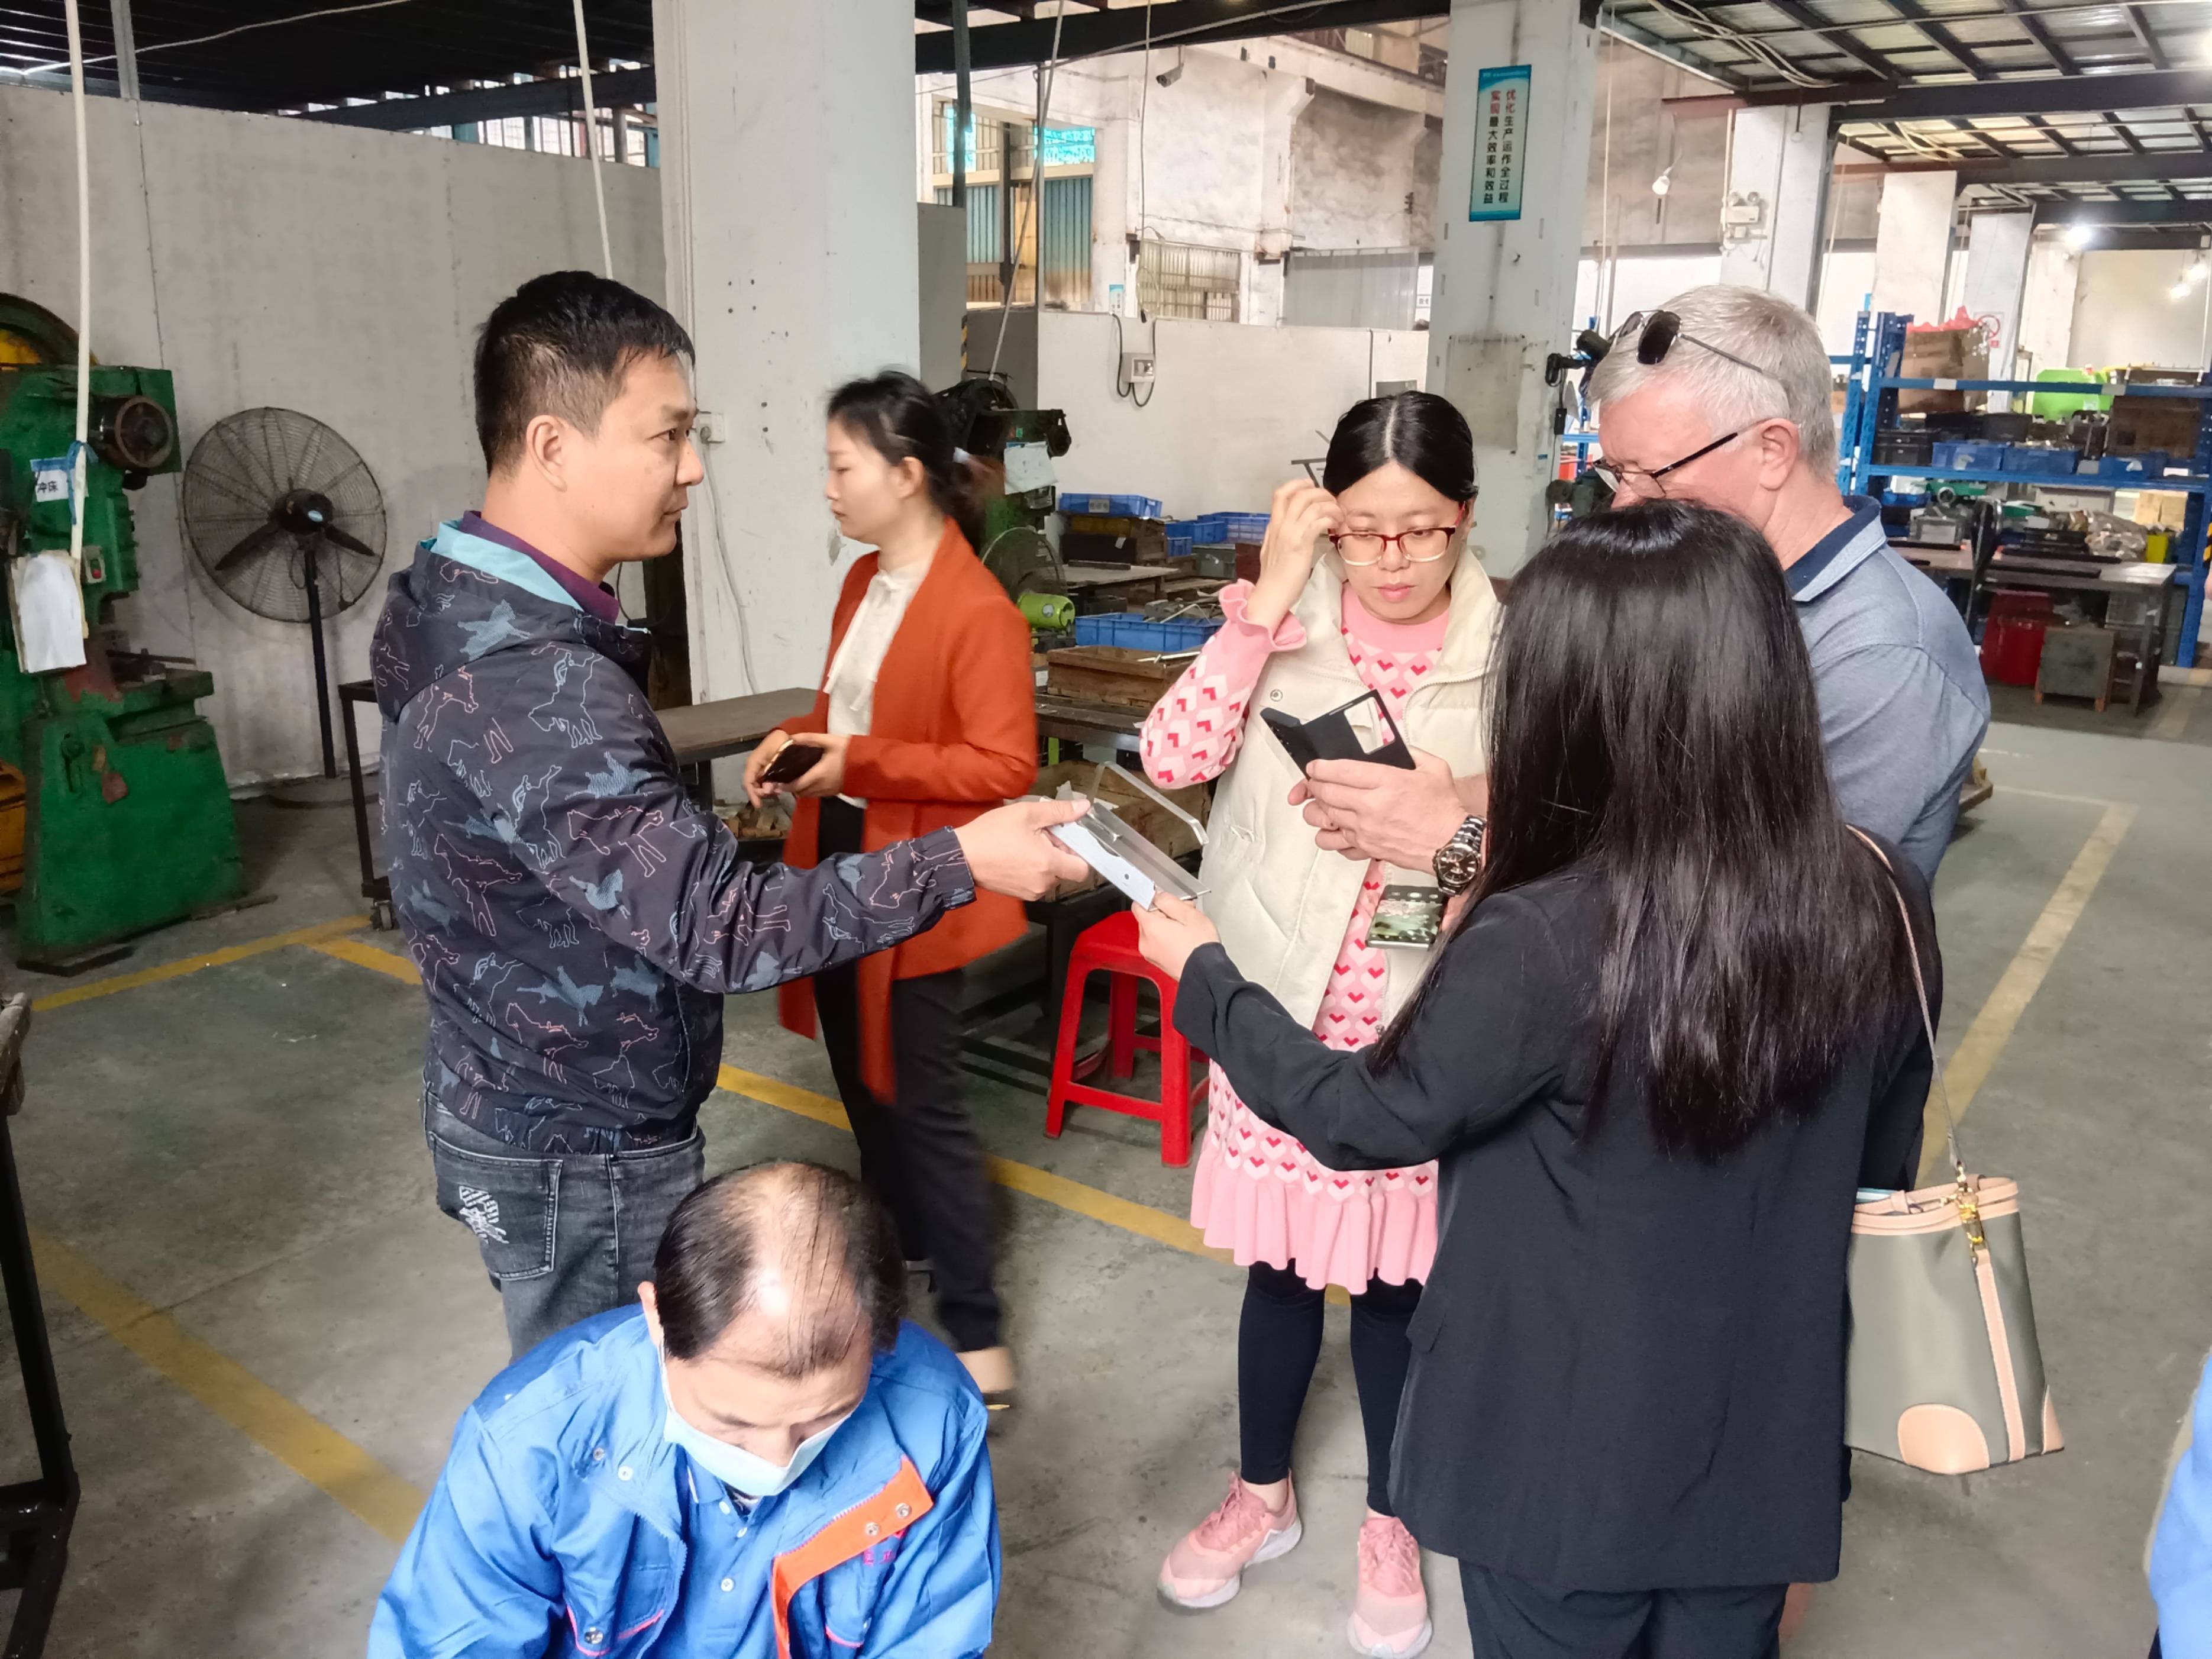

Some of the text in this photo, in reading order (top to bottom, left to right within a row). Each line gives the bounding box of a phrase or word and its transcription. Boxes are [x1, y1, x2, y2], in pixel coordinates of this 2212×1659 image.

[1498, 89, 1516, 203] 优化生产运作全过程
